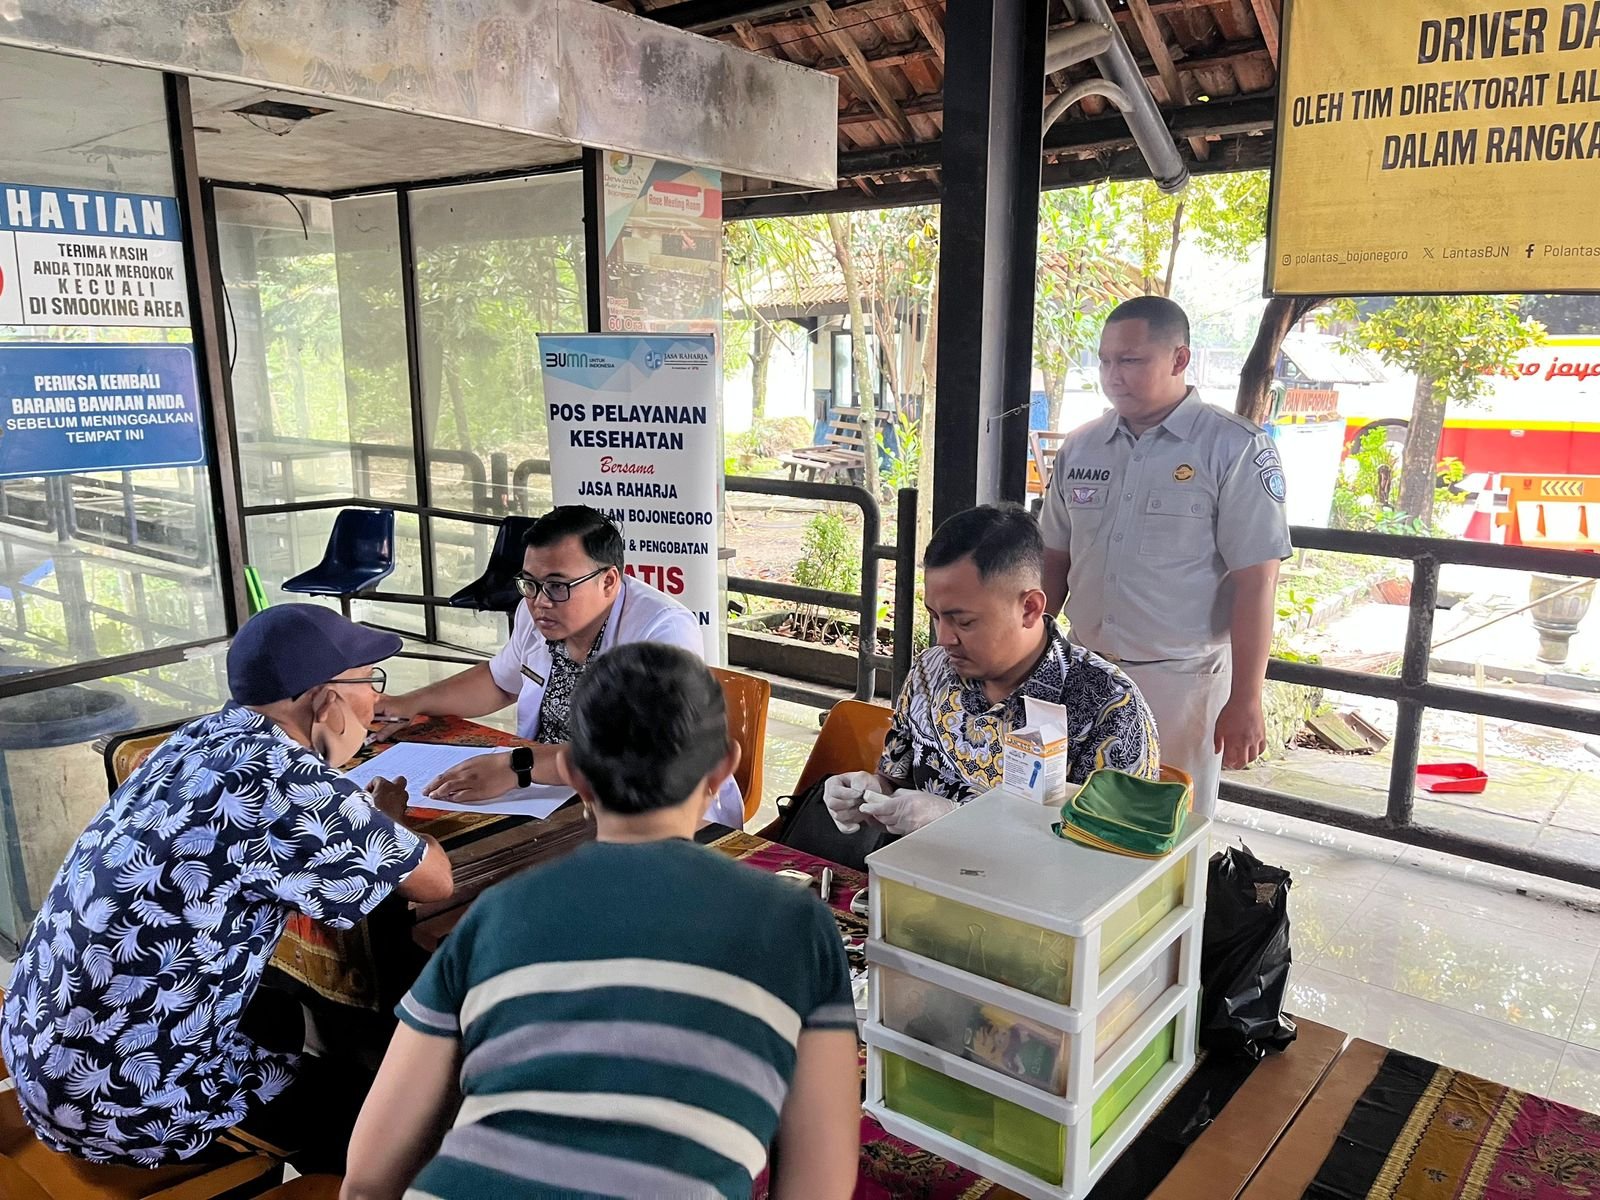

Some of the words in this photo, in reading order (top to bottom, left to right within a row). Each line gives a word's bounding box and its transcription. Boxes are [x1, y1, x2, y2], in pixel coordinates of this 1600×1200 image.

[1418, 7, 1548, 64] DRIVER
[1558, 1, 1600, 50] DA
[1292, 91, 1344, 127] OLEH
[1351, 87, 1393, 120] TIM
[1400, 73, 1550, 116] DIREKTORAT
[1556, 69, 1600, 104] LAL
[1381, 128, 1478, 170] DALAM
[1485, 121, 1600, 163] RANGKA
[0, 188, 165, 236] HATIAN
[58, 243, 107, 260] TERIMA
[110, 245, 148, 262] KASIH
[1295, 249, 1408, 266] polantas_bojonegoro
[1442, 245, 1510, 259] LantasBJN
[1543, 243, 1600, 257] Polantas
[33, 261, 70, 276] ANDA
[73, 262, 112, 278] TIDAK
[116, 264, 174, 281] MEROKOK
[30, 297, 46, 315] DI
[52, 297, 139, 316] SMOOKING
[144, 299, 185, 318] AREA
[609, 317, 621, 331] 60
[34, 374, 98, 392] PERIKSA
[100, 373, 161, 390] KEMBALI
[11, 396, 76, 415] BARANG
[78, 395, 144, 412] BAWAAN
[146, 393, 185, 410] ANDA
[6, 416, 78, 431] SEBELUM
[81, 412, 193, 428] MENINGGALKAN
[550, 404, 586, 421] POS
[592, 404, 707, 424] PELAYANAN
[66, 431, 123, 444] TEMPAT
[126, 430, 144, 441] INI
[570, 430, 683, 450] KESEHATAN
[600, 456, 655, 475] Bersama
[1067, 467, 1110, 481] ANANG
[578, 481, 613, 496] JASA
[617, 482, 678, 499] RAHARJA
[629, 509, 713, 525] BOJONEGORO
[629, 539, 637, 551] &
[640, 540, 708, 554] PENGOBATAN
